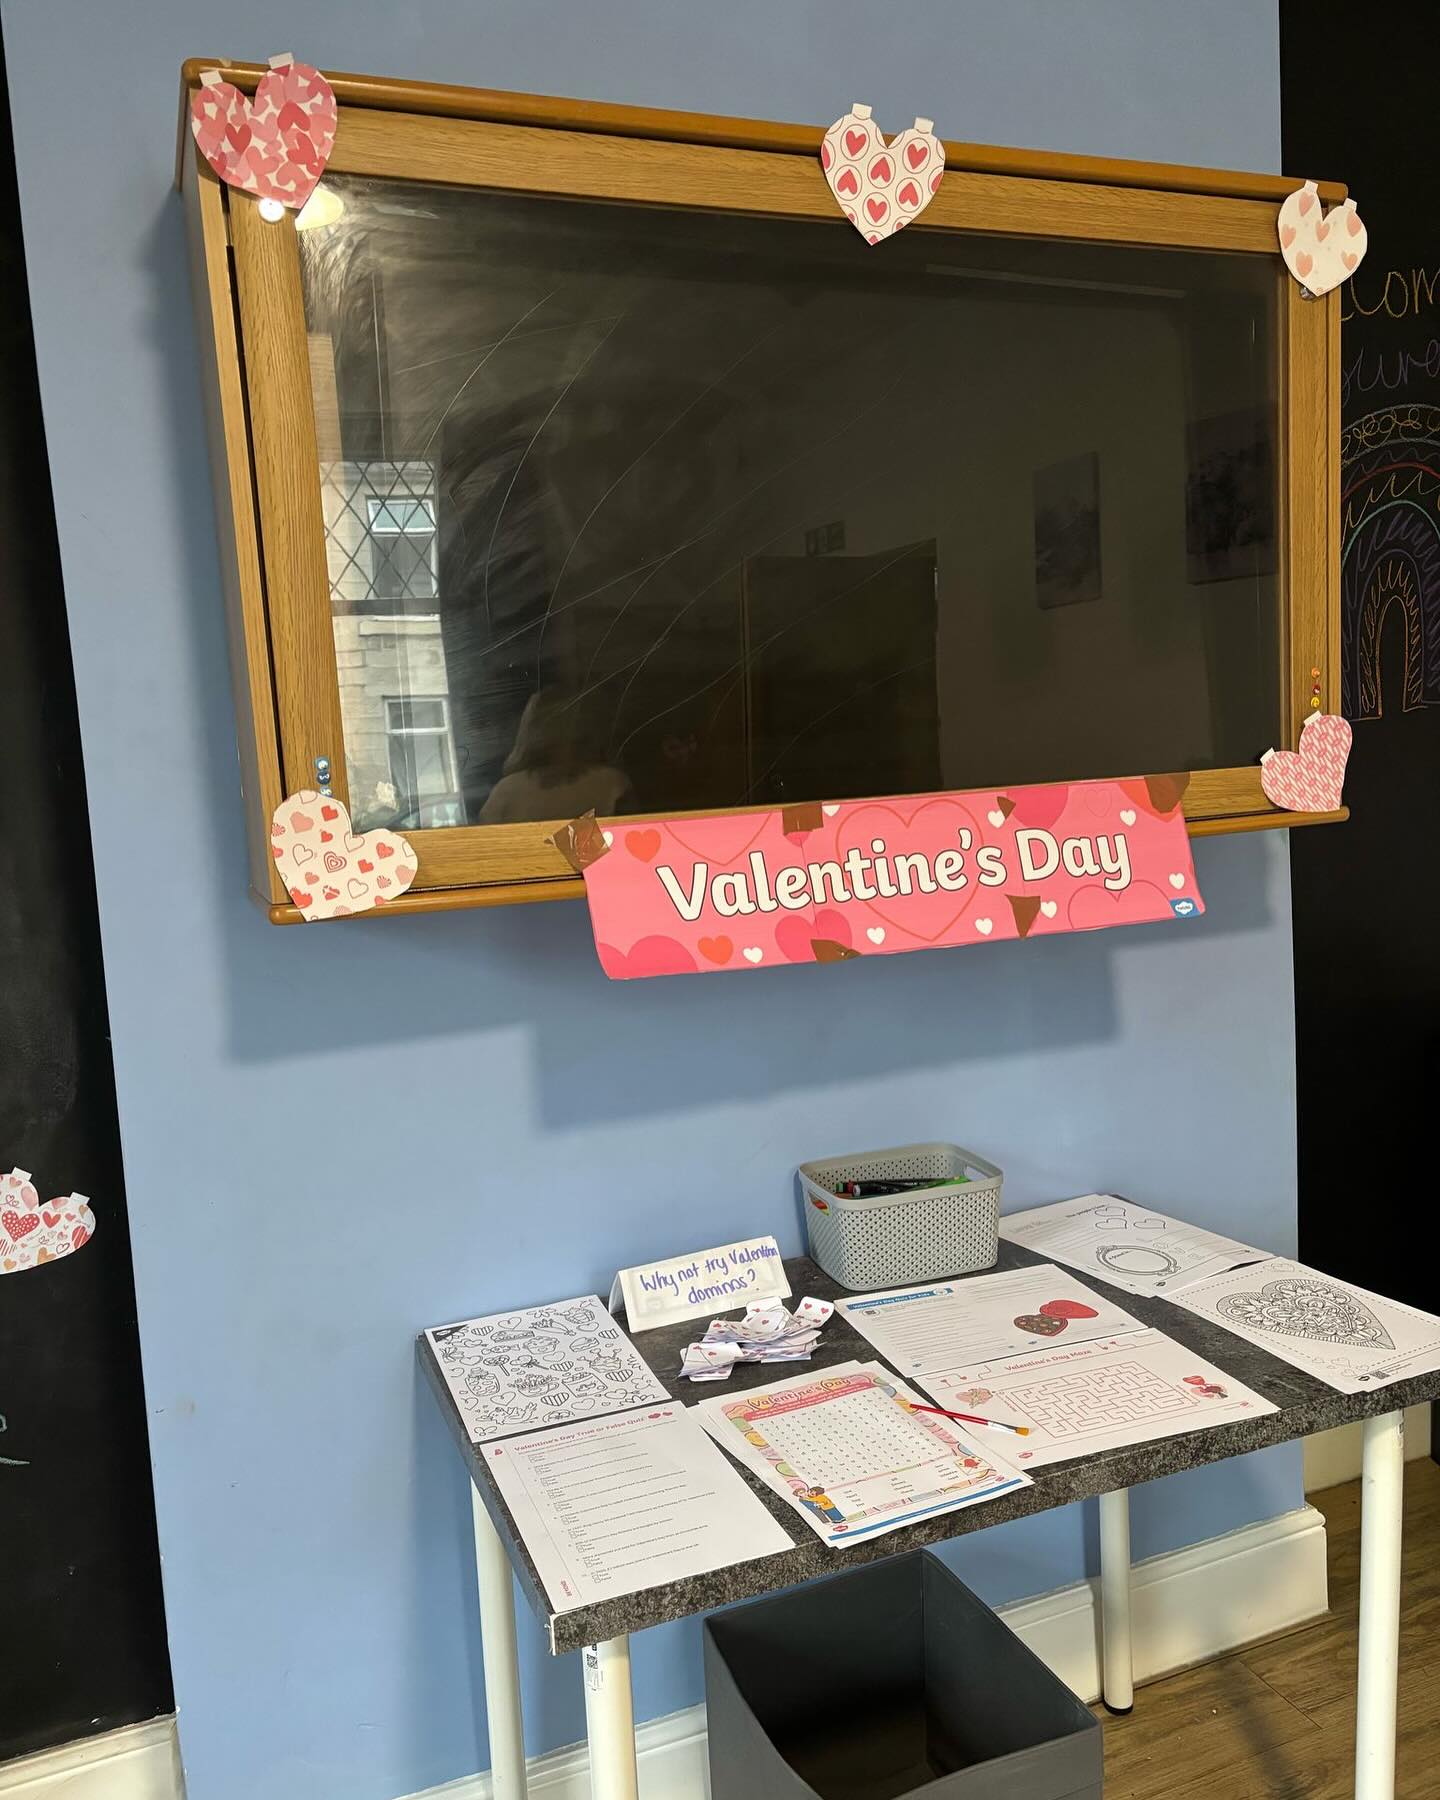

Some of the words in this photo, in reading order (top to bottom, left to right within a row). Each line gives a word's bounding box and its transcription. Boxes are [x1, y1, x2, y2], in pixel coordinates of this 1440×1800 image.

[656, 828, 1007, 921] Valentine's
[1015, 827, 1133, 890] Day
[640, 1271, 679, 1296] Why
[677, 1262, 699, 1282] not
[705, 1257, 729, 1275] try
[1005, 1357, 1052, 1371] Valentine's
[1051, 1353, 1070, 1362] Day
[750, 1385, 823, 1408] Valentine's
[823, 1378, 852, 1391] Day
[514, 1438, 559, 1451] Valentine's
[559, 1432, 576, 1442] Day
